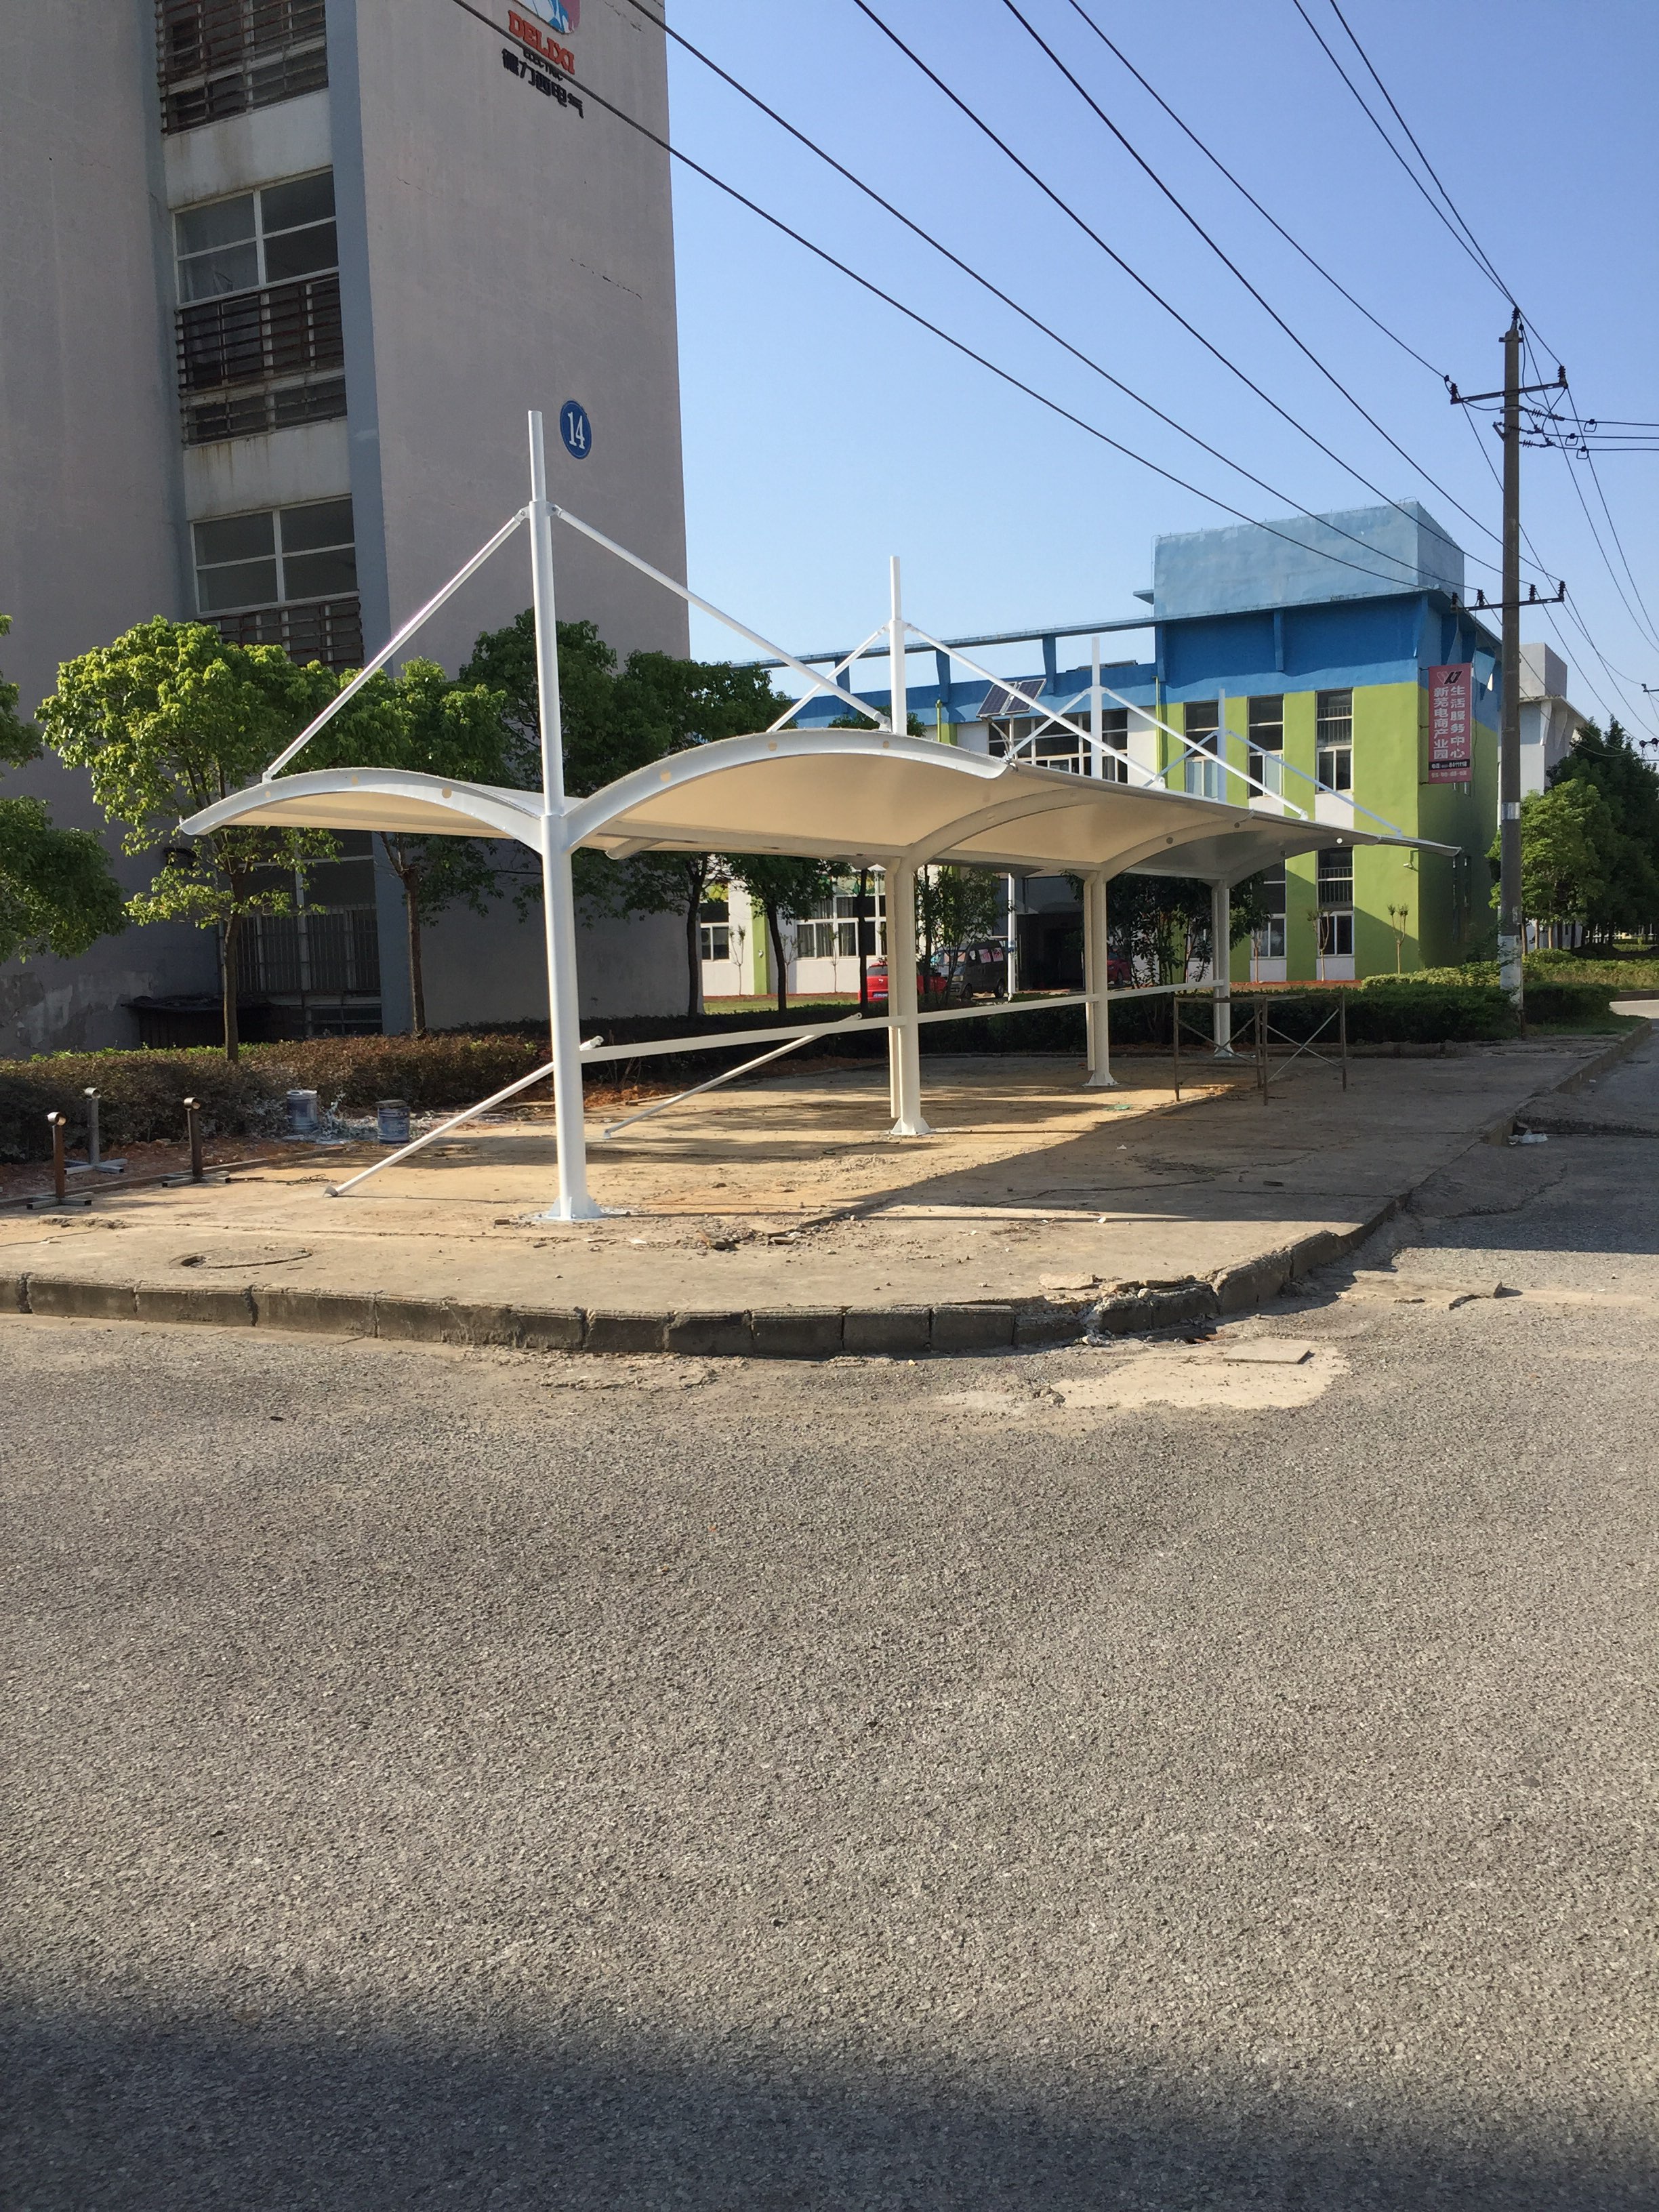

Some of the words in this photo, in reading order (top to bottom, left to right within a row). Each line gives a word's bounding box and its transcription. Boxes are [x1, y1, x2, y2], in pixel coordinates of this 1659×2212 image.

[508, 9, 575, 75] DELIXI
[567, 411, 585, 449] 14
[1433, 687, 1449, 759] 新芜电商产业园
[1450, 685, 1465, 758] 生活服务中心
